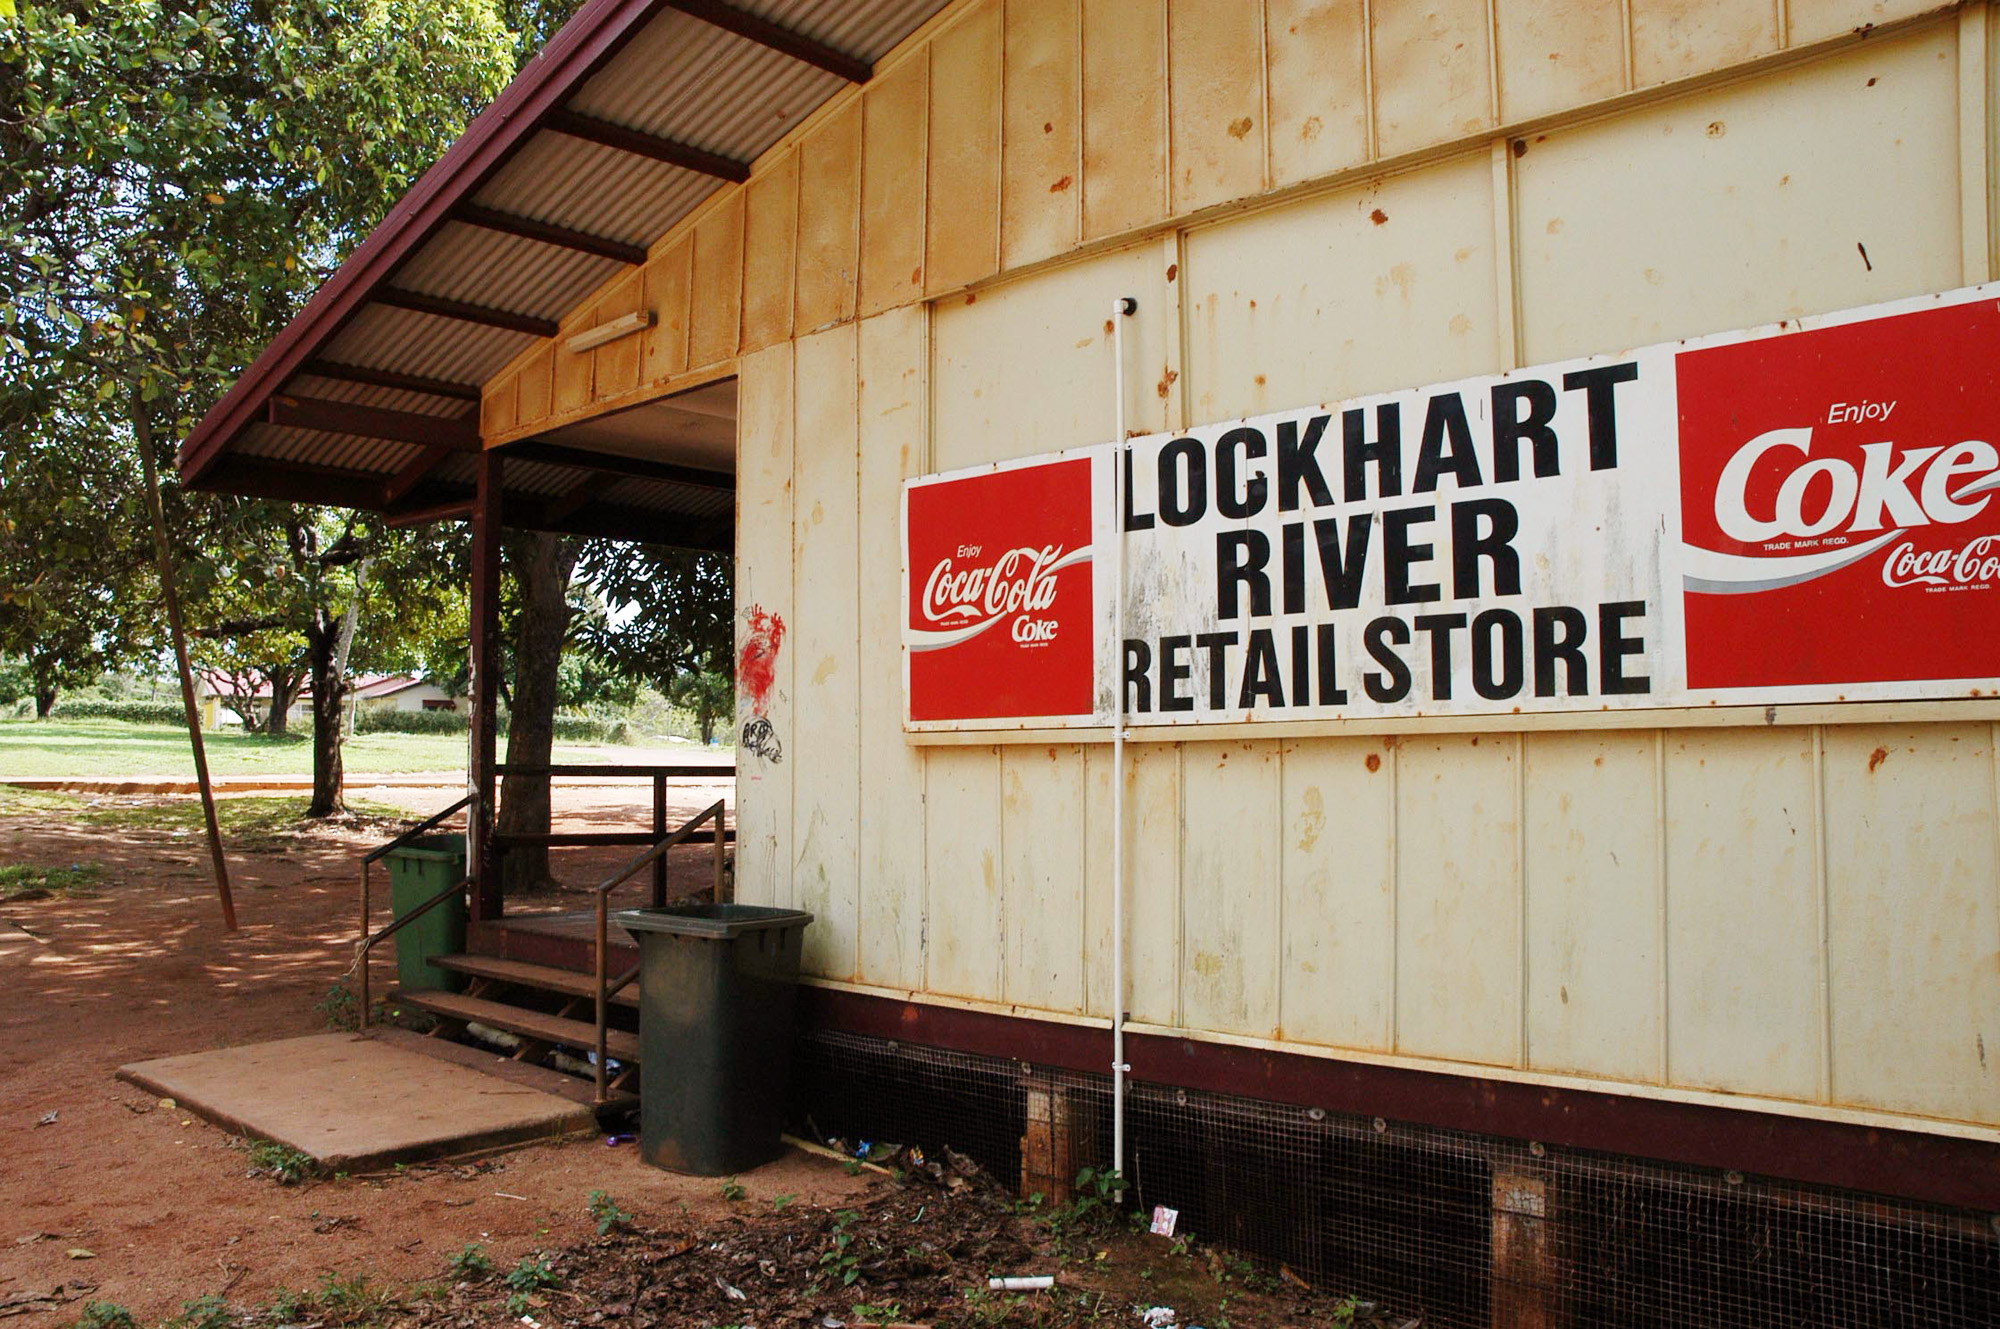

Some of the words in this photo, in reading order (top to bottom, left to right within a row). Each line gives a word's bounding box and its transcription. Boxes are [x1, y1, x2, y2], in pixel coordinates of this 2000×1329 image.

[1828, 400, 1896, 424] Enjoy
[1115, 362, 1638, 533] LOCKHART
[1714, 427, 1999, 542] Coke
[957, 544, 982, 558] Enjoy
[1216, 498, 1522, 620] RIVER
[1763, 542, 1791, 551] TRADE
[1794, 540, 1819, 549] MARK
[1882, 534, 2000, 588] Coca-Co
[922, 544, 1063, 621] Coca-Cola
[1012, 615, 1058, 642] Coke
[1122, 623, 1348, 714] RETAIL
[1363, 600, 1651, 704] STORE
